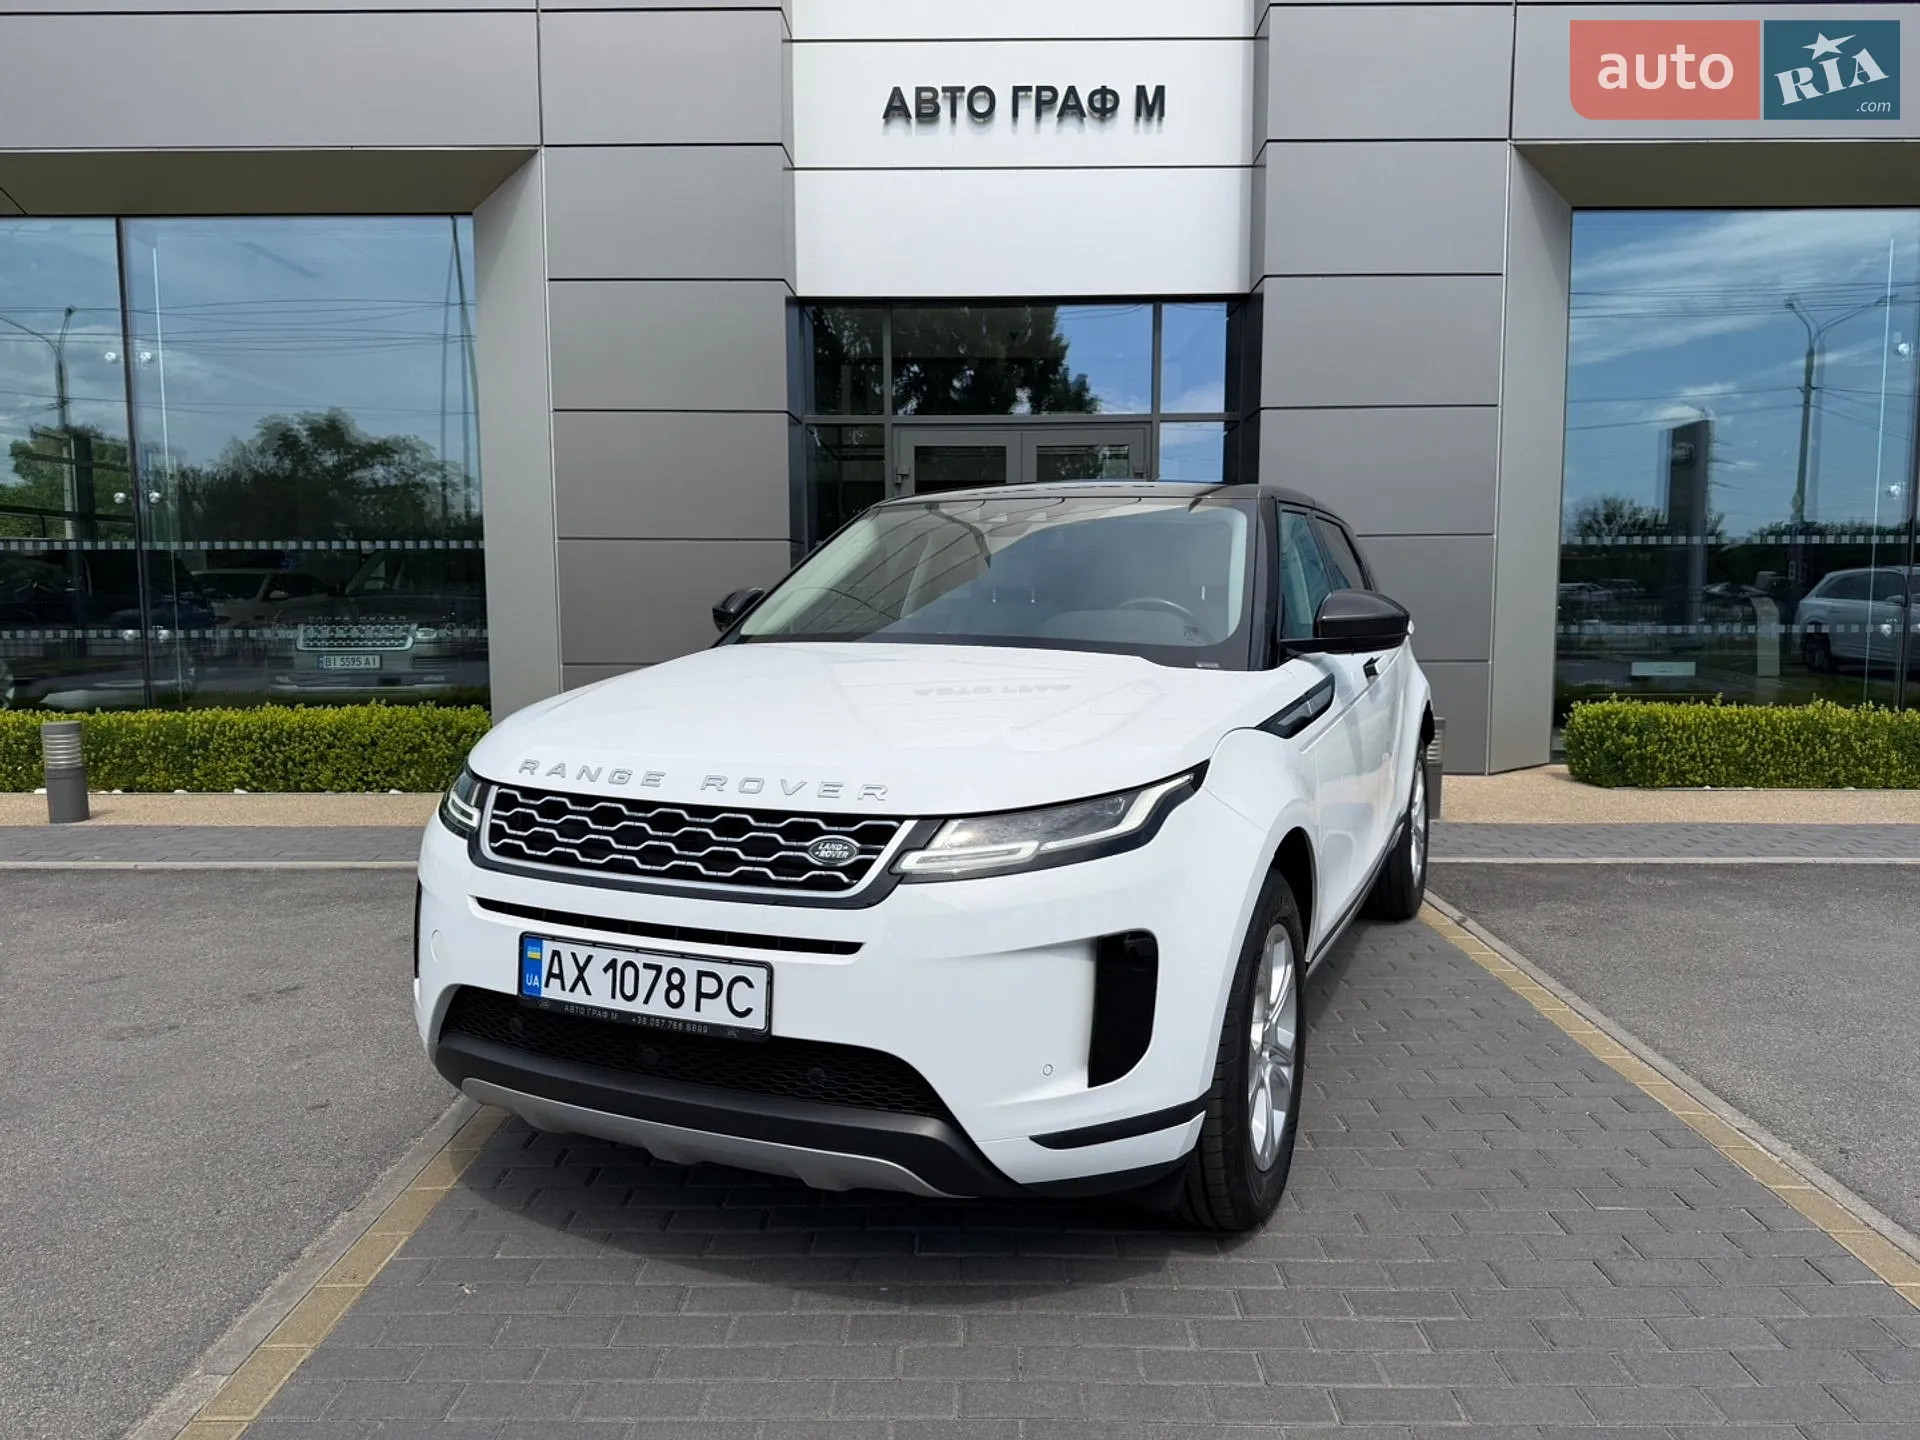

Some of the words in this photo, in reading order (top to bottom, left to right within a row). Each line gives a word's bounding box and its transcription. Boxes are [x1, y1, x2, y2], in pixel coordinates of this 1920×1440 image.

[882, 85, 997, 119] АВТО
[1012, 85, 1120, 118] ГРАФ
[1135, 85, 1166, 118] М
[518, 758, 666, 788] RANGE
[700, 774, 889, 801] ROVER
[525, 974, 539, 988] UA
[544, 949, 594, 996] AX
[602, 957, 686, 1009] 1078
[694, 969, 755, 1018] PC
